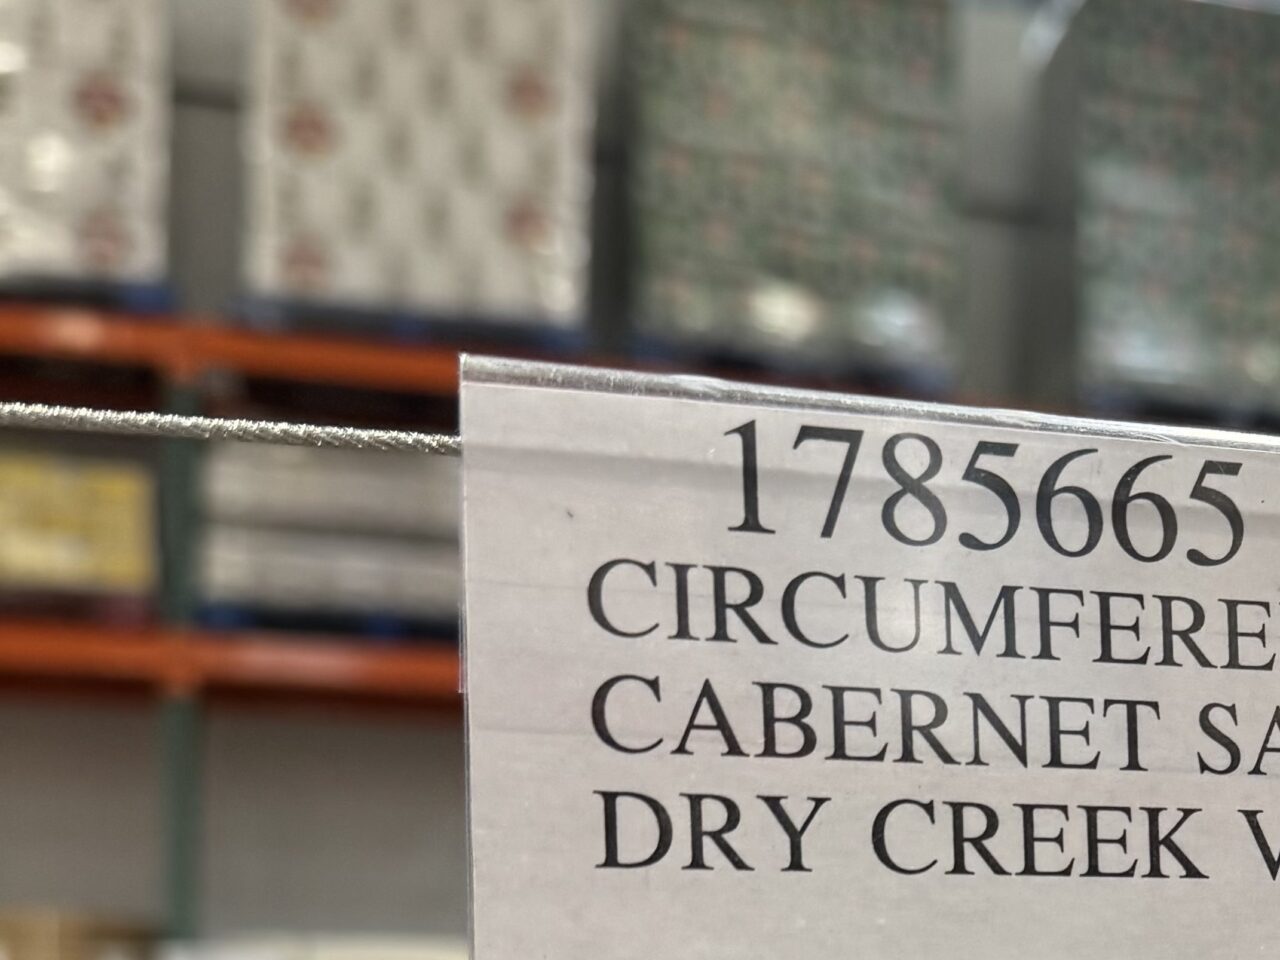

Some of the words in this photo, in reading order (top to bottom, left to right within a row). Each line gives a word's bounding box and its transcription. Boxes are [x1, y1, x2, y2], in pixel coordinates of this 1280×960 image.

[725, 419, 1245, 567] 1785665
[590, 674, 1161, 772] CABERNET
[592, 790, 832, 873] DRY
[872, 798, 1209, 880] CREEK
